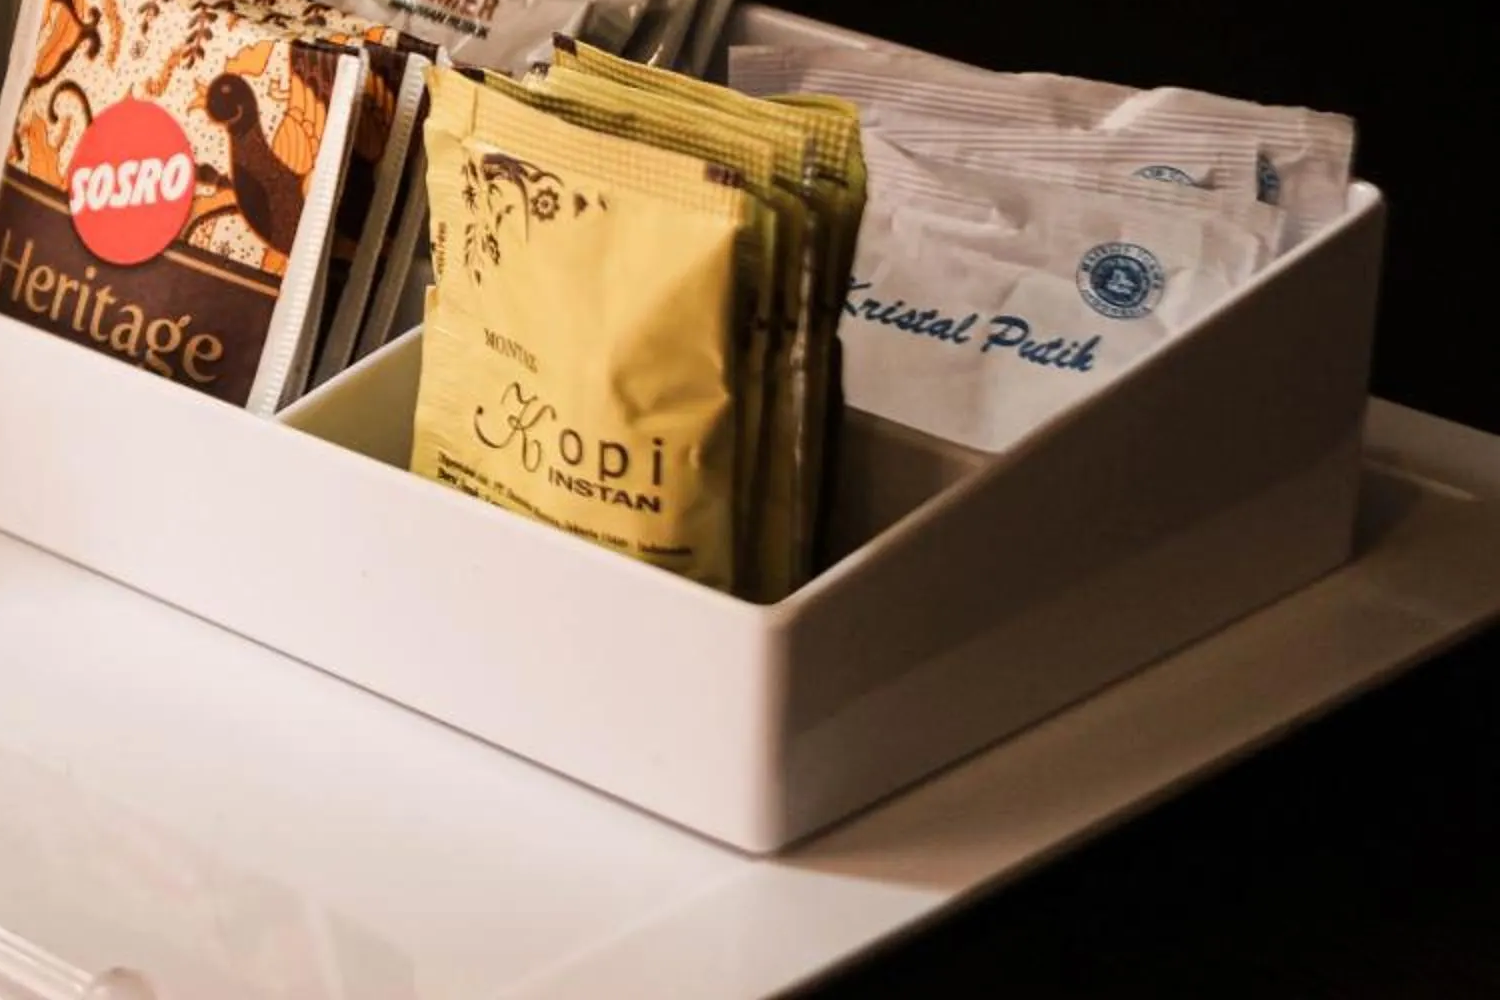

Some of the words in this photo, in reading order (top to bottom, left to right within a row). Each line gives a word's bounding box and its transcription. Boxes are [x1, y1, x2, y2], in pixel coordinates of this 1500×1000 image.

[70, 152, 193, 216] SOSRO
[980, 315, 1102, 373] Putik
[474, 381, 666, 488] Kopi
[548, 466, 662, 514] INSTAN
